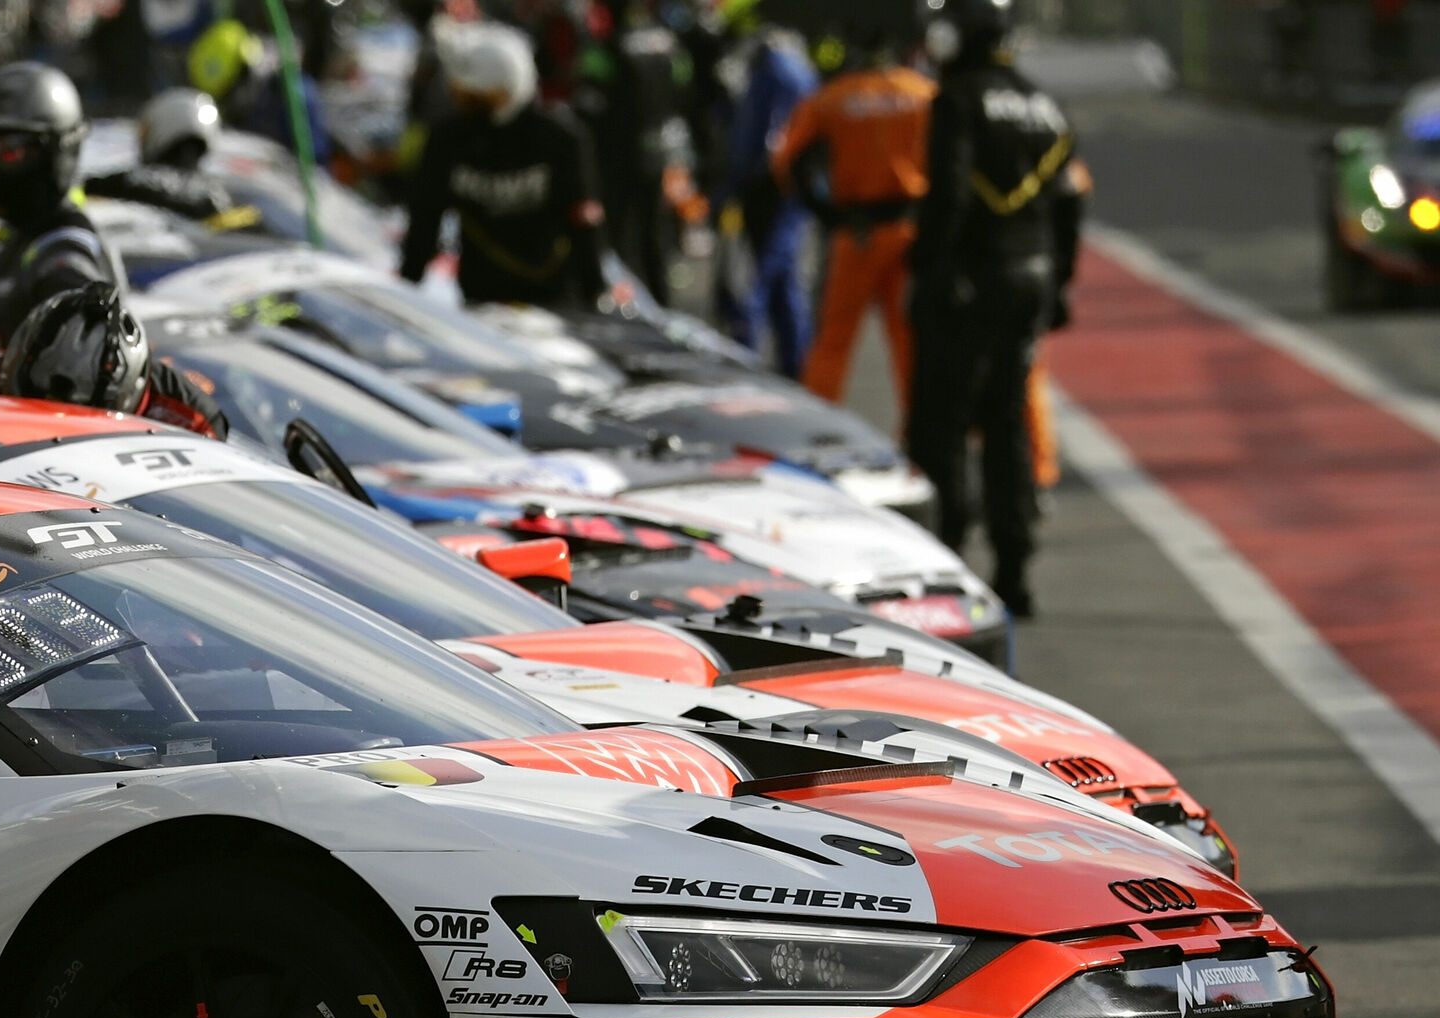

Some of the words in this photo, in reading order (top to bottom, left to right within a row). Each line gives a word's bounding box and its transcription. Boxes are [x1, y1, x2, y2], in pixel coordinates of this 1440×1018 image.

[26, 520, 123, 549] GT
[71, 547, 110, 560] WORLD
[109, 543, 168, 555] CHALLENGE
[631, 874, 912, 914] SKECHERS
[414, 913, 490, 940] OMP
[450, 953, 528, 980] R8
[446, 988, 549, 1009] Snap-on
